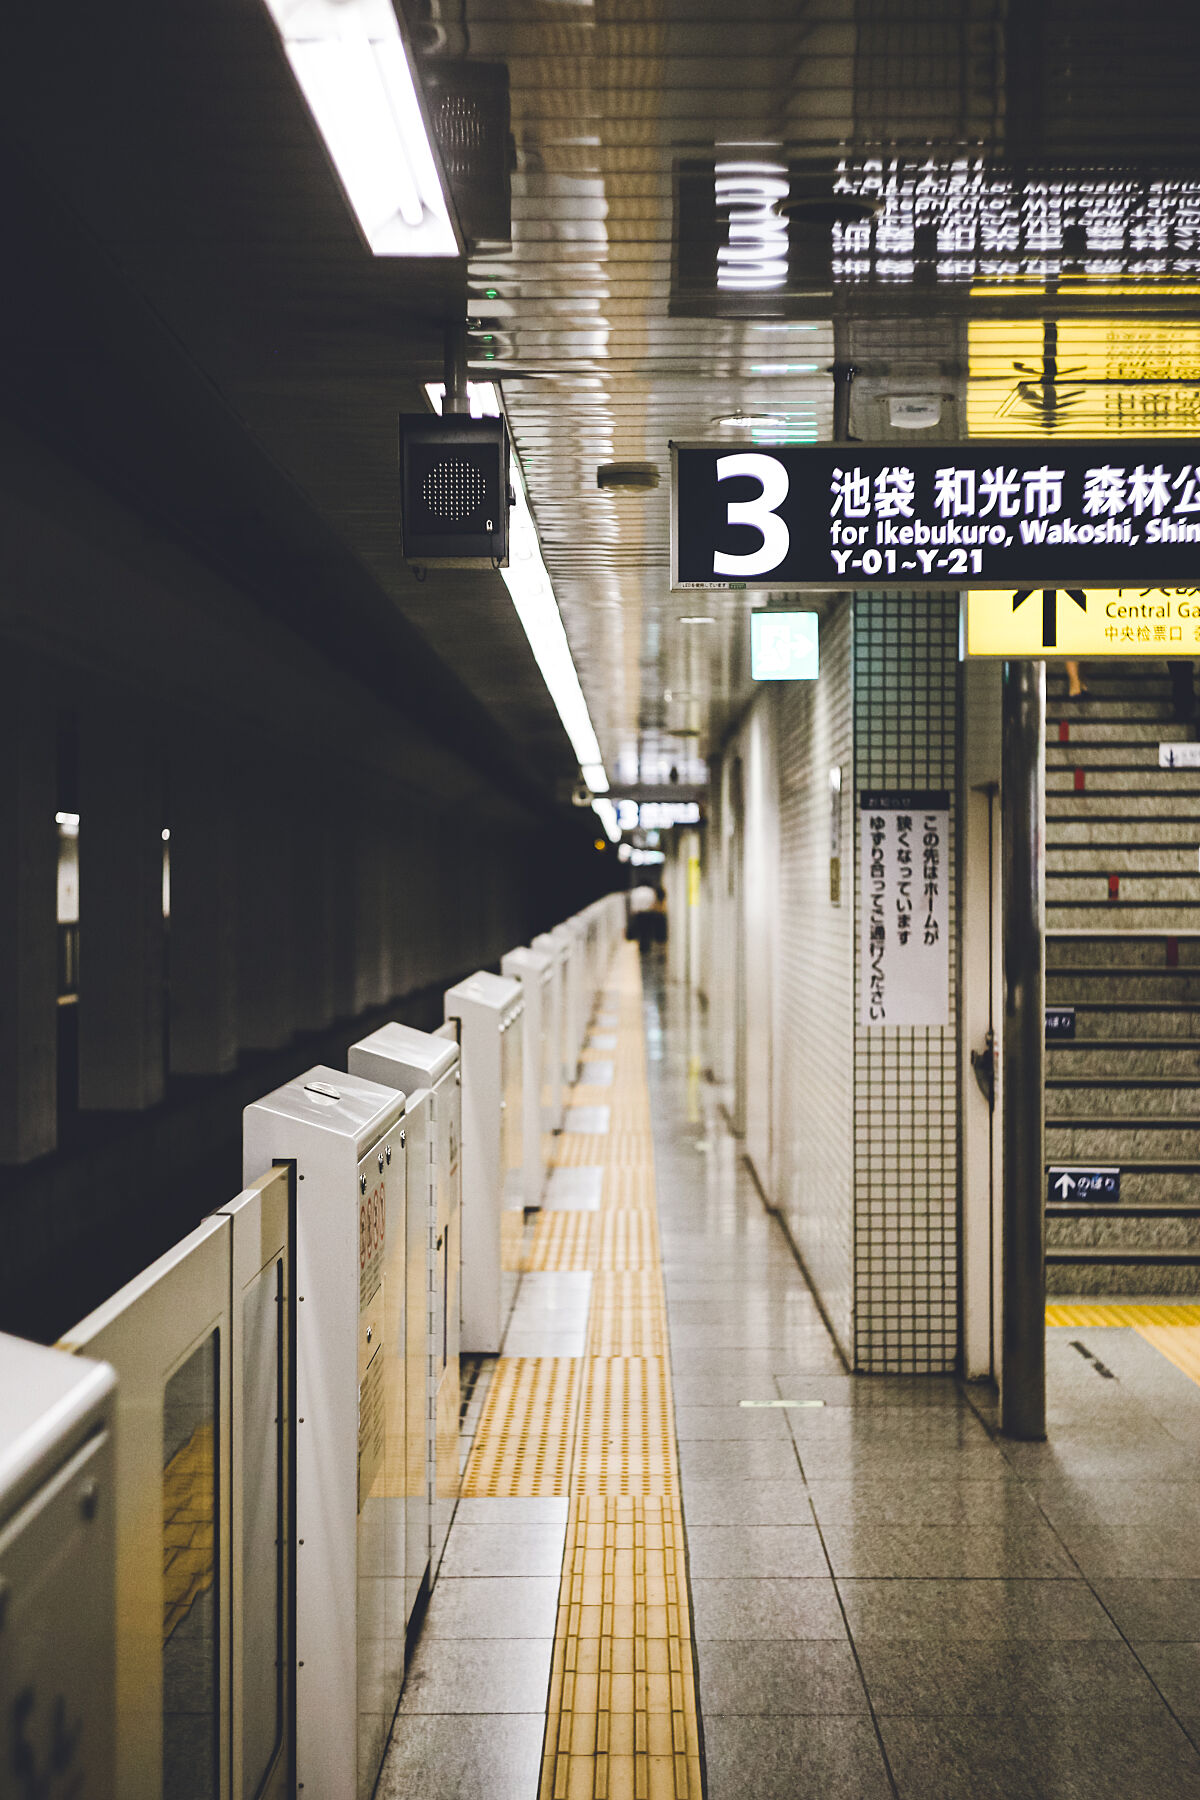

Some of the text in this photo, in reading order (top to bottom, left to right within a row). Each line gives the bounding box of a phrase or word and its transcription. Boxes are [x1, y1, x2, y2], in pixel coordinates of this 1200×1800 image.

[713, 453, 790, 577] 3
[830, 466, 915, 518] 池袋
[934, 465, 1066, 518] 和光市
[830, 519, 869, 545] for
[876, 518, 1012, 548] Ikebukuro,
[1019, 517, 1140, 547] Wakoshi,
[1104, 624, 1182, 642] 中央检票口
[1105, 601, 1170, 619] Central
[896, 815, 913, 945] 狭くなっています
[923, 815, 940, 946] この先はホームが
